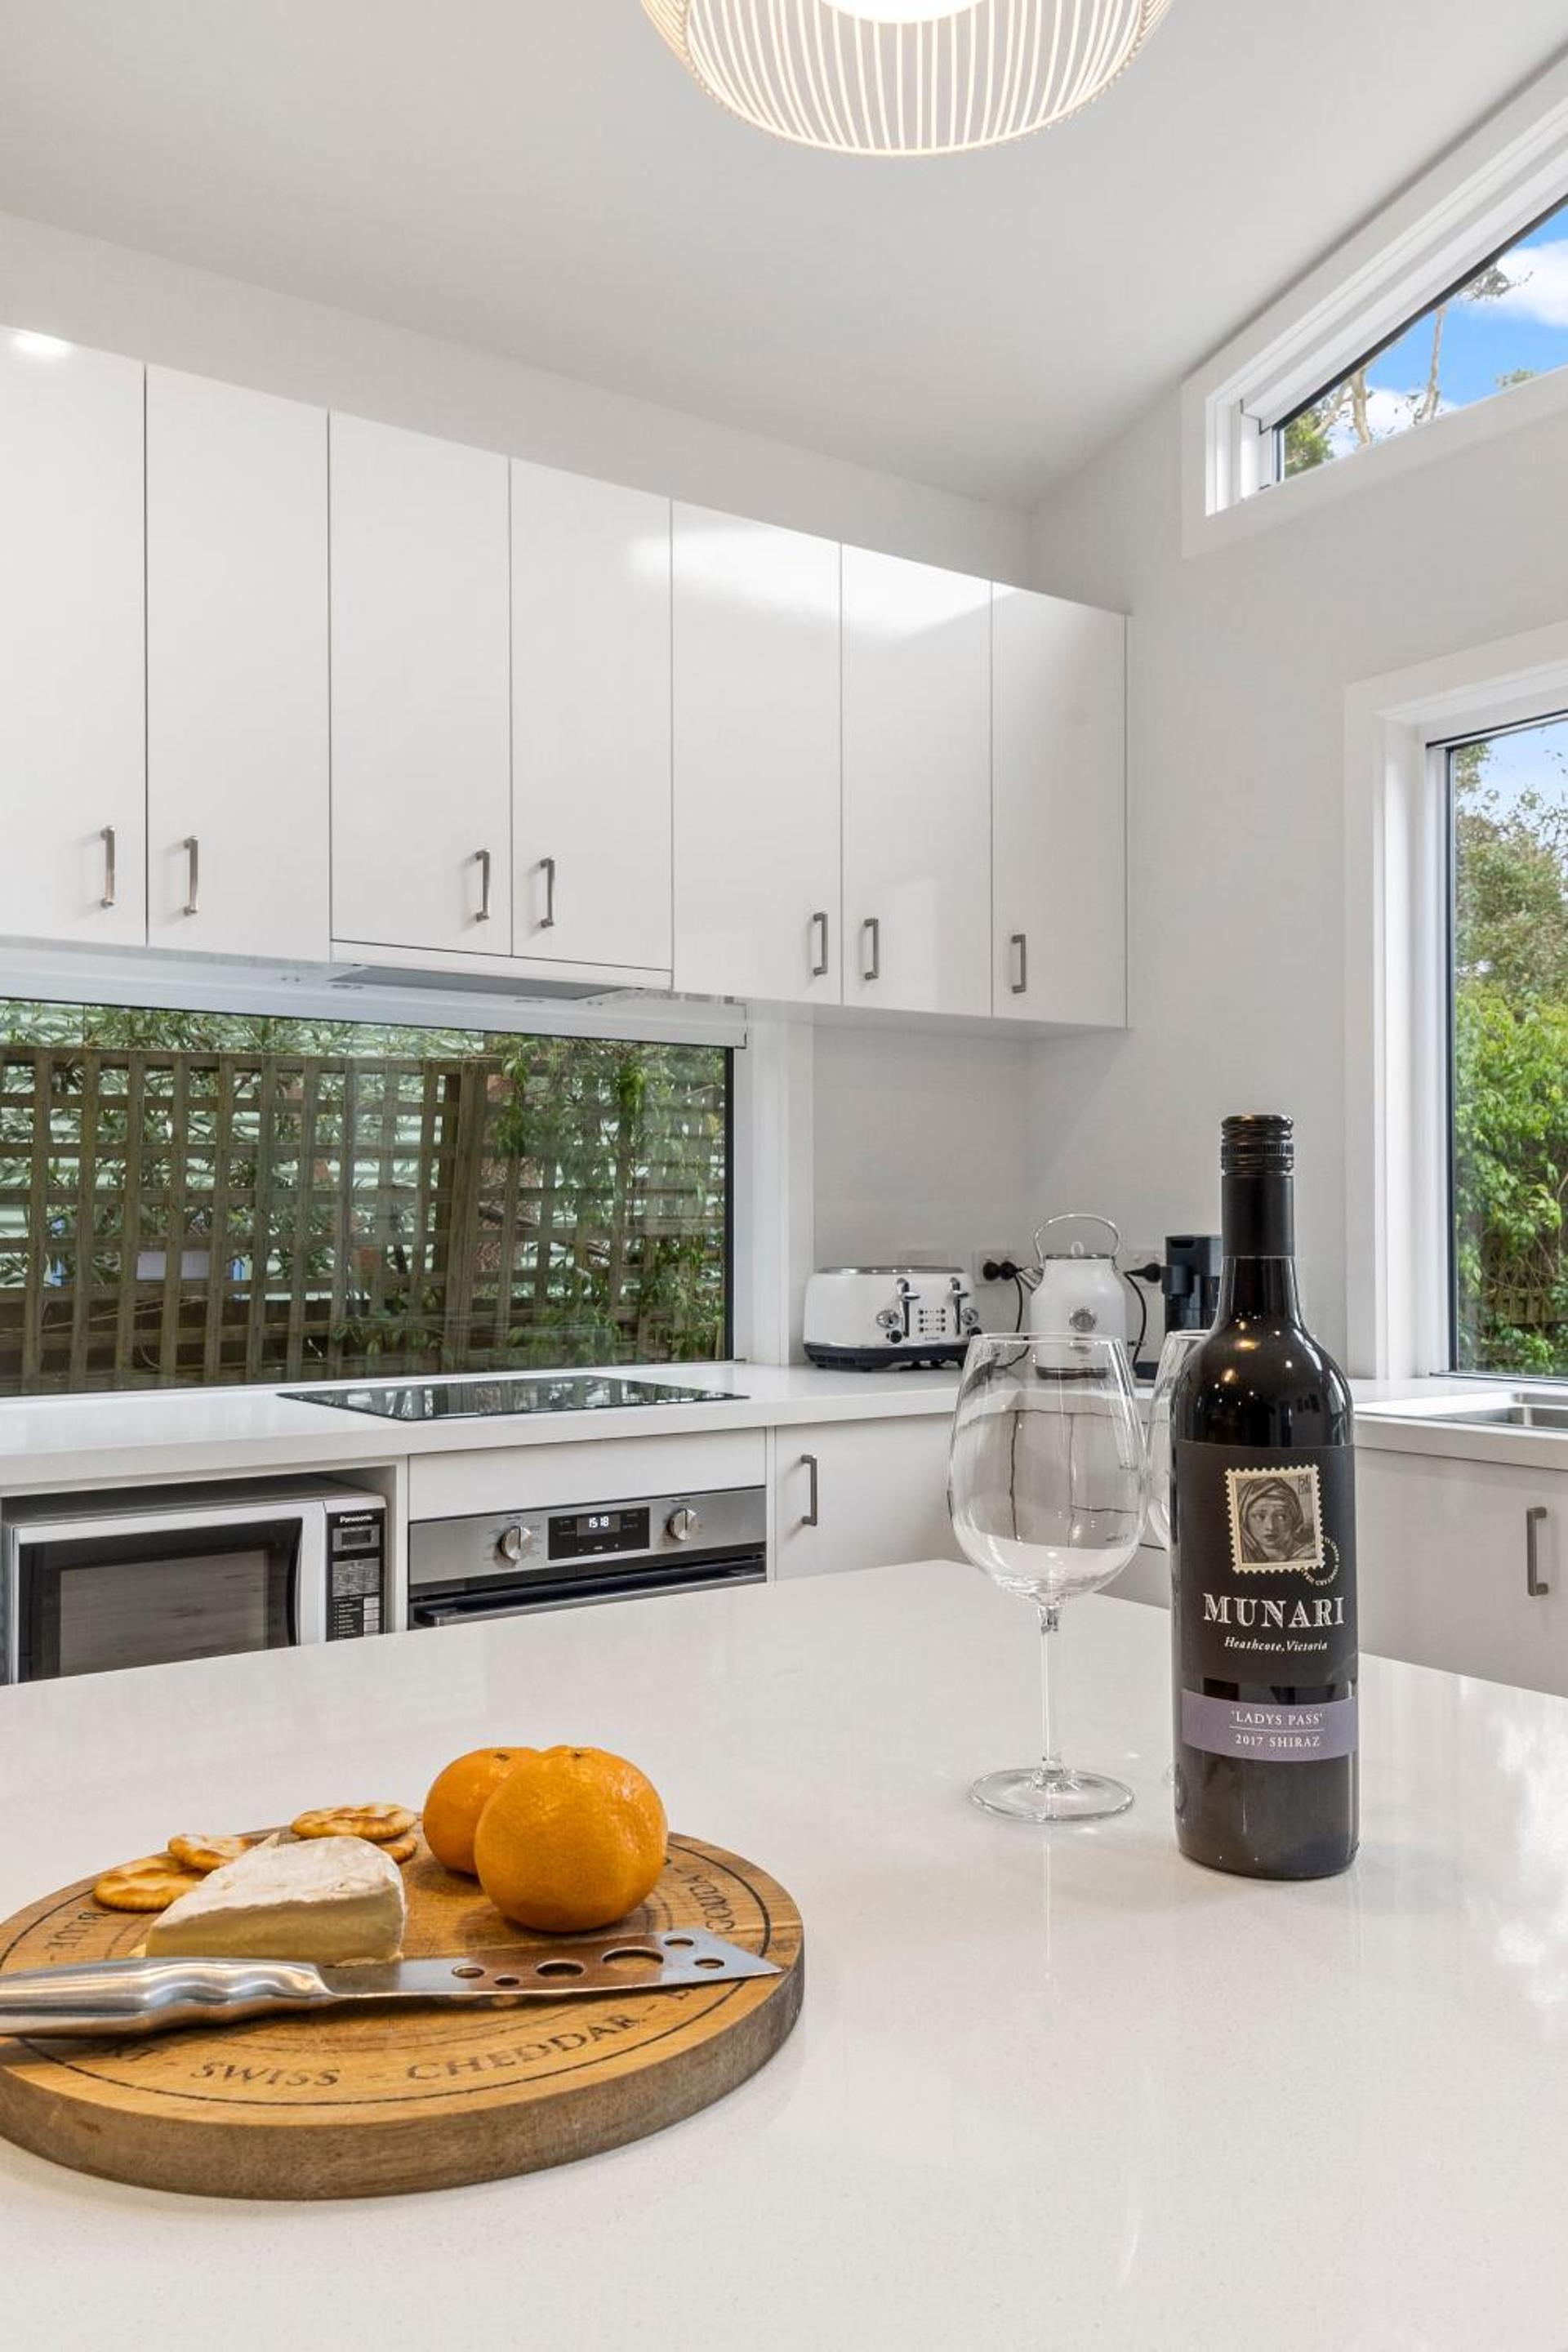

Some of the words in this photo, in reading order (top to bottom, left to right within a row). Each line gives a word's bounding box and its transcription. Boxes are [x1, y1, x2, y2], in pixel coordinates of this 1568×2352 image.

[1203, 1592, 1345, 1628] MUNARI
[1235, 1733, 1263, 1746] 2017
[1269, 1735, 1321, 1748] SHIRAZ
[189, 2059, 341, 2087] SWISS
[408, 2014, 640, 2081] CHEDDAR
